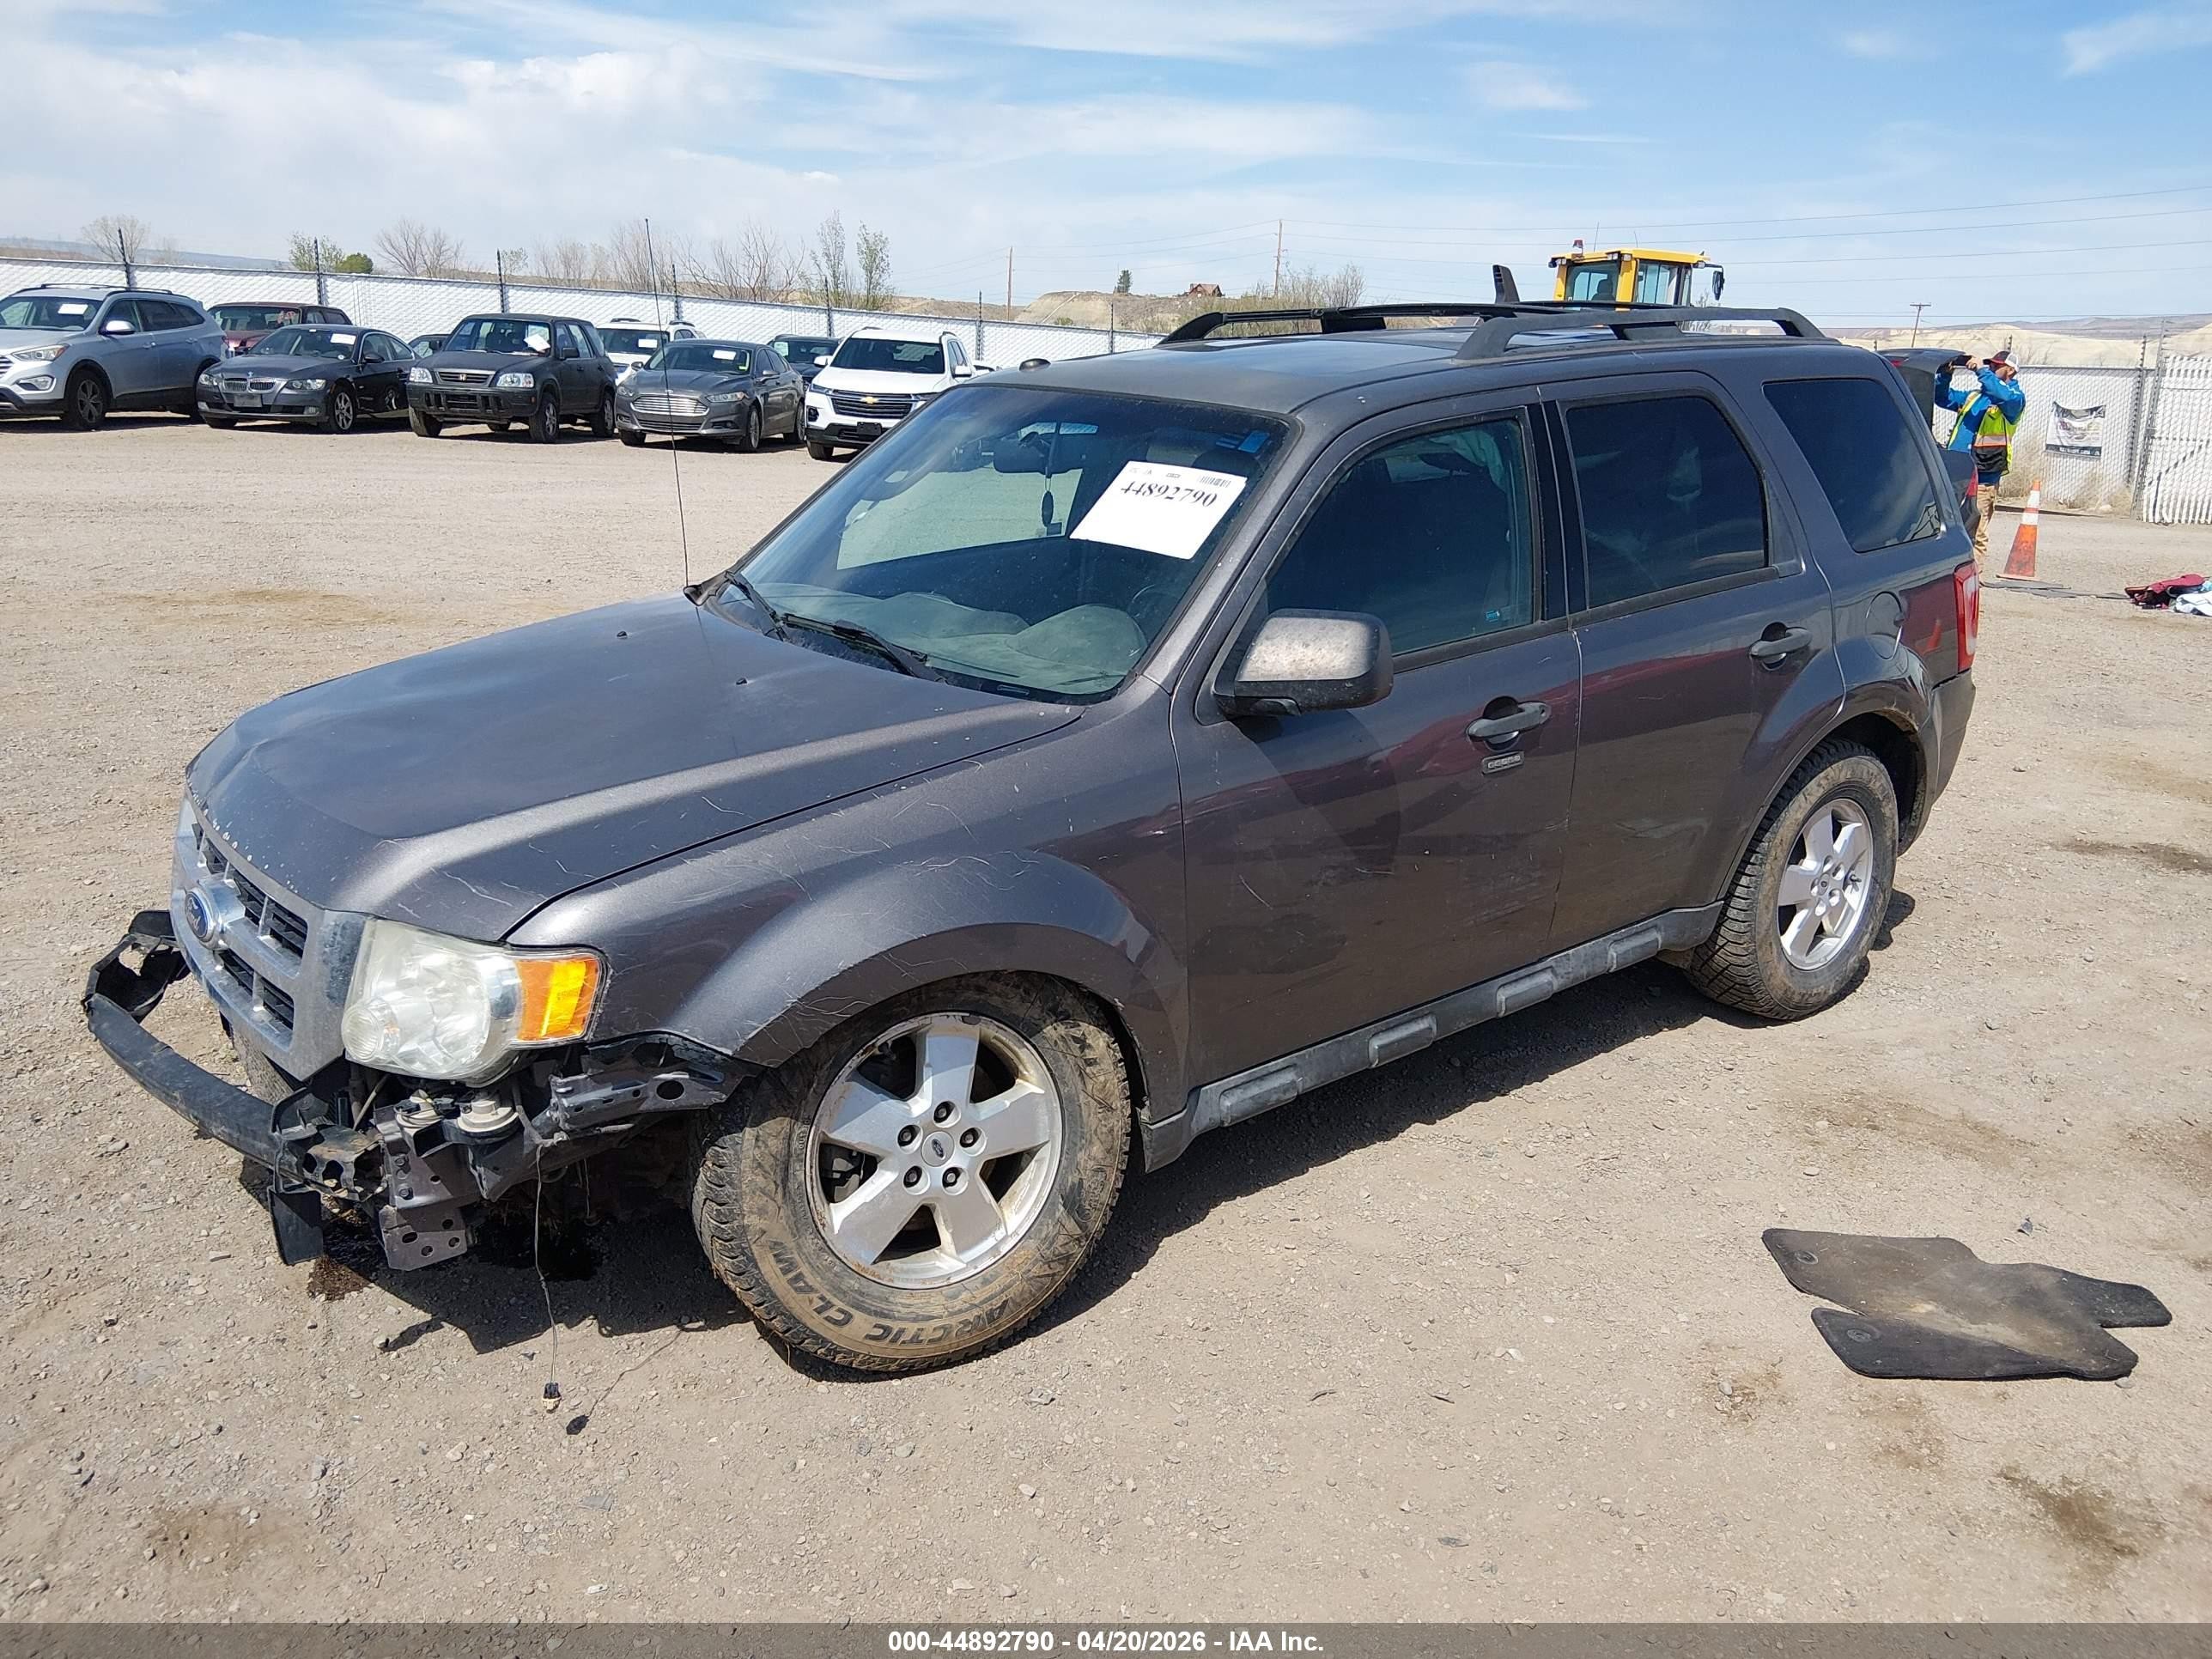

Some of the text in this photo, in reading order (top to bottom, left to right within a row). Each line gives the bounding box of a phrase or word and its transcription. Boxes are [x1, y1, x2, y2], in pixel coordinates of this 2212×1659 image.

[1121, 480, 1218, 507] 44892790
[768, 1239, 854, 1328] CLAW
[864, 1297, 1010, 1346] ARCTIC
